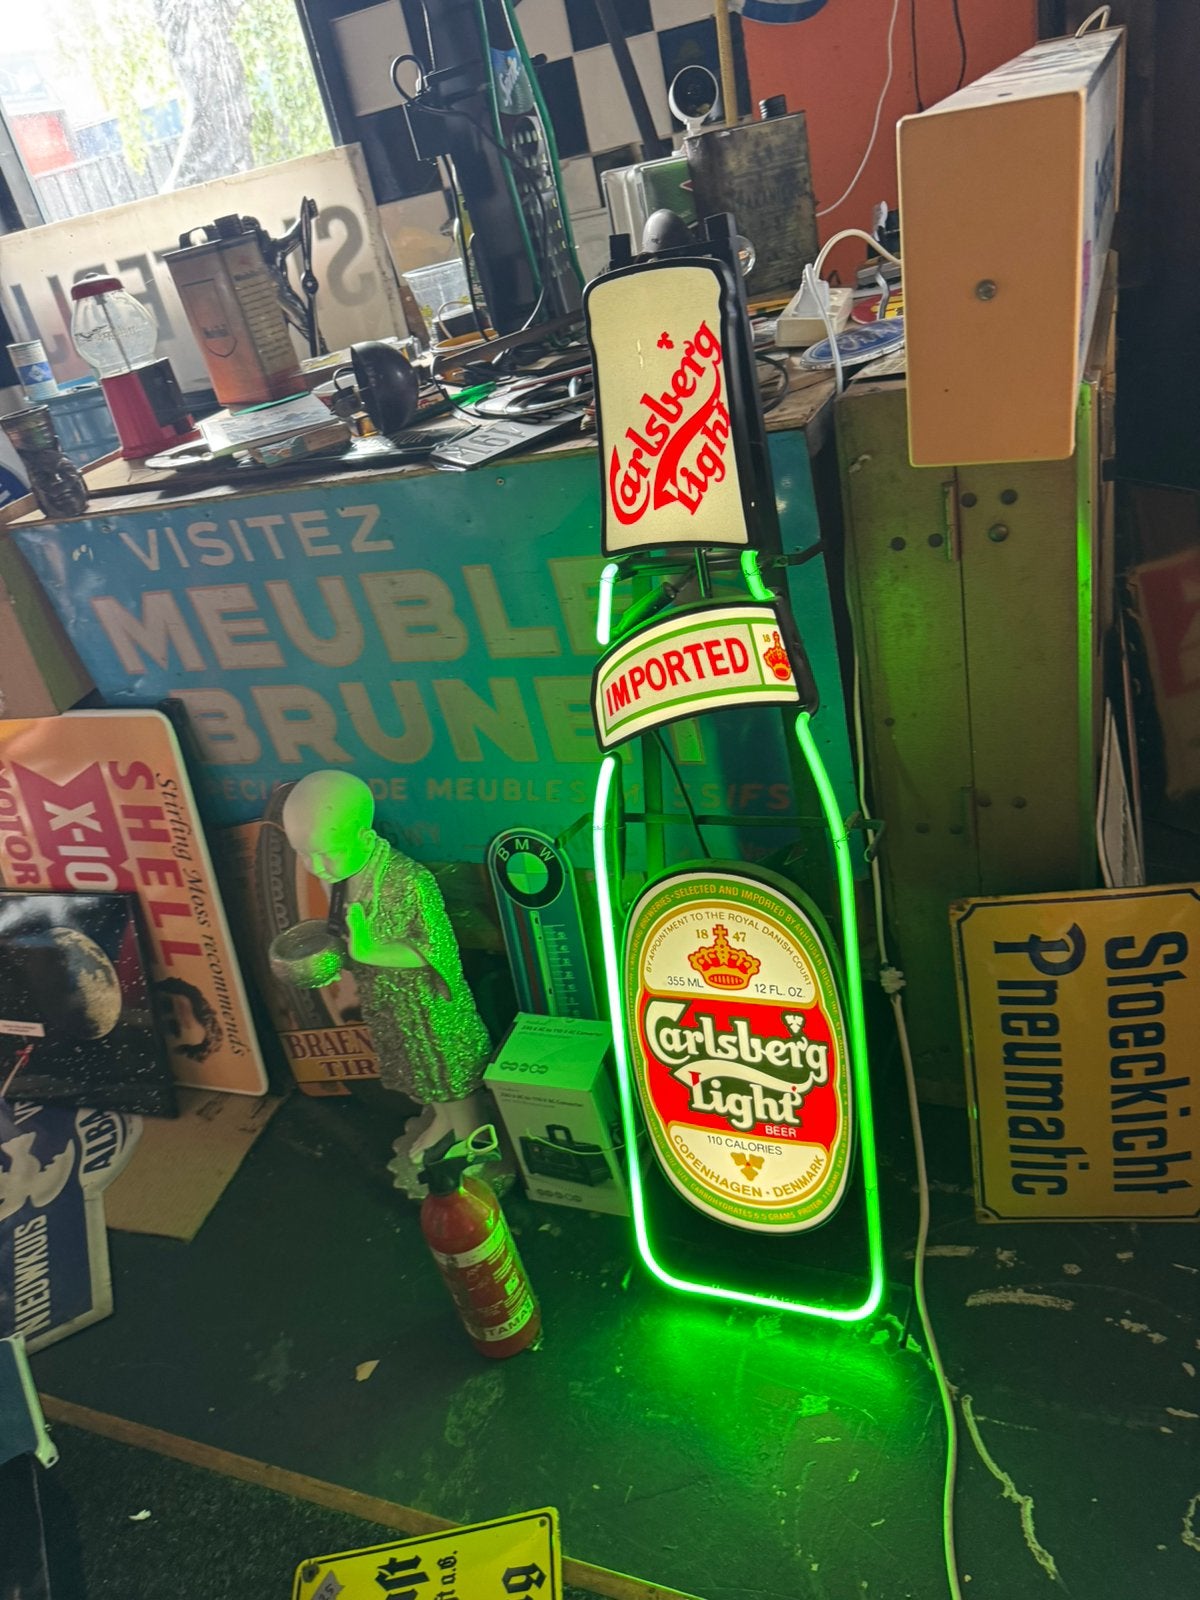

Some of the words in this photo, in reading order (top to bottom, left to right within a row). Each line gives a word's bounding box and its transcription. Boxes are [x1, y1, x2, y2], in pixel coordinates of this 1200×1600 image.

[609, 320, 723, 525] Carlsberg
[118, 503, 395, 572] VISITEZ
[91, 555, 645, 675] MEUBLE
[605, 636, 749, 717] IMPORTED
[369, 778, 408, 801] DE
[426, 778, 588, 804] MEUBLES
[43, 800, 120, 891] X-10
[108, 760, 204, 967] SHELL
[497, 837, 556, 862] BMW
[674, 884, 716, 899] SELECTED
[719, 886, 738, 896] AND
[741, 889, 784, 917] IMPORTED
[785, 914, 797, 927] BY
[695, 929, 709, 940] 18
[732, 931, 747, 943] 47
[182, 868, 213, 931] Moss
[200, 932, 251, 1057] recommends
[650, 916, 688, 960] APPOINTMENT
[690, 912, 704, 921] TO
[705, 911, 725, 920] THE
[728, 913, 760, 930] ROYAL
[760, 926, 792, 955] DANISH
[791, 953, 811, 986] COURT
[667, 975, 686, 987] 355
[687, 977, 705, 989] ML
[754, 983, 767, 994] 12
[645, 1000, 829, 1084] Carlsberg
[993, 921, 1090, 1196] Pneumatic
[1104, 930, 1195, 1194] Stoeckicht
[687, 1070, 802, 1129] Light
[765, 1125, 797, 1138] BEER
[673, 1134, 763, 1198] COPENHAGEN
[773, 1155, 825, 1198] DENMARK
[706, 1134, 723, 1147] 110
[724, 1138, 783, 1156] CALORIES
[14, 1214, 51, 1338] NIEUWKUIS
